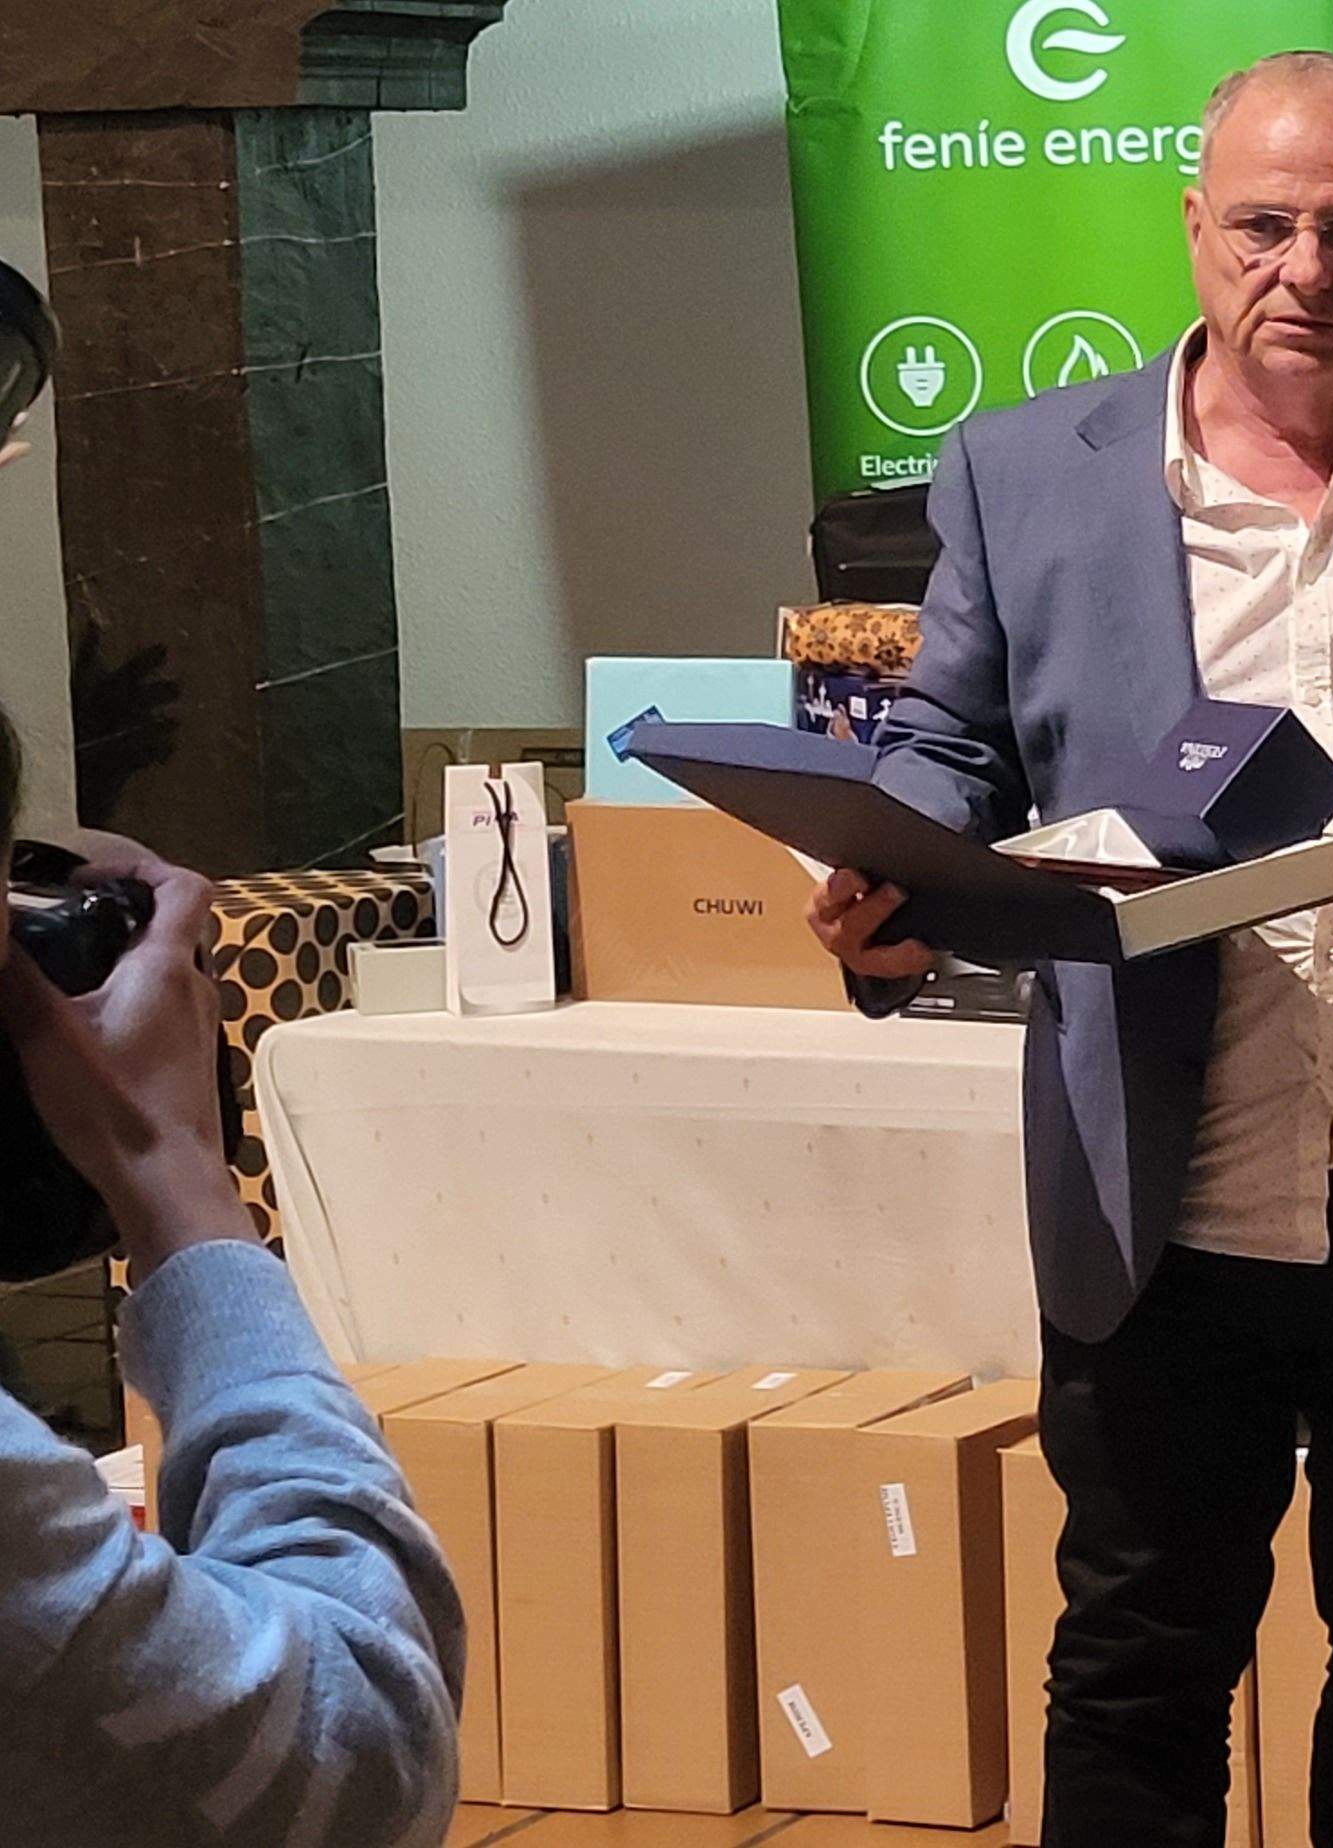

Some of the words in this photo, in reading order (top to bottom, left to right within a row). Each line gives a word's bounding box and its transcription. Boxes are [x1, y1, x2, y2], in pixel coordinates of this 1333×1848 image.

[878, 119, 1026, 171] feníe
[1043, 125, 1204, 175] energ
[861, 453, 938, 476] Electri
[693, 898, 764, 916] CHUWI
